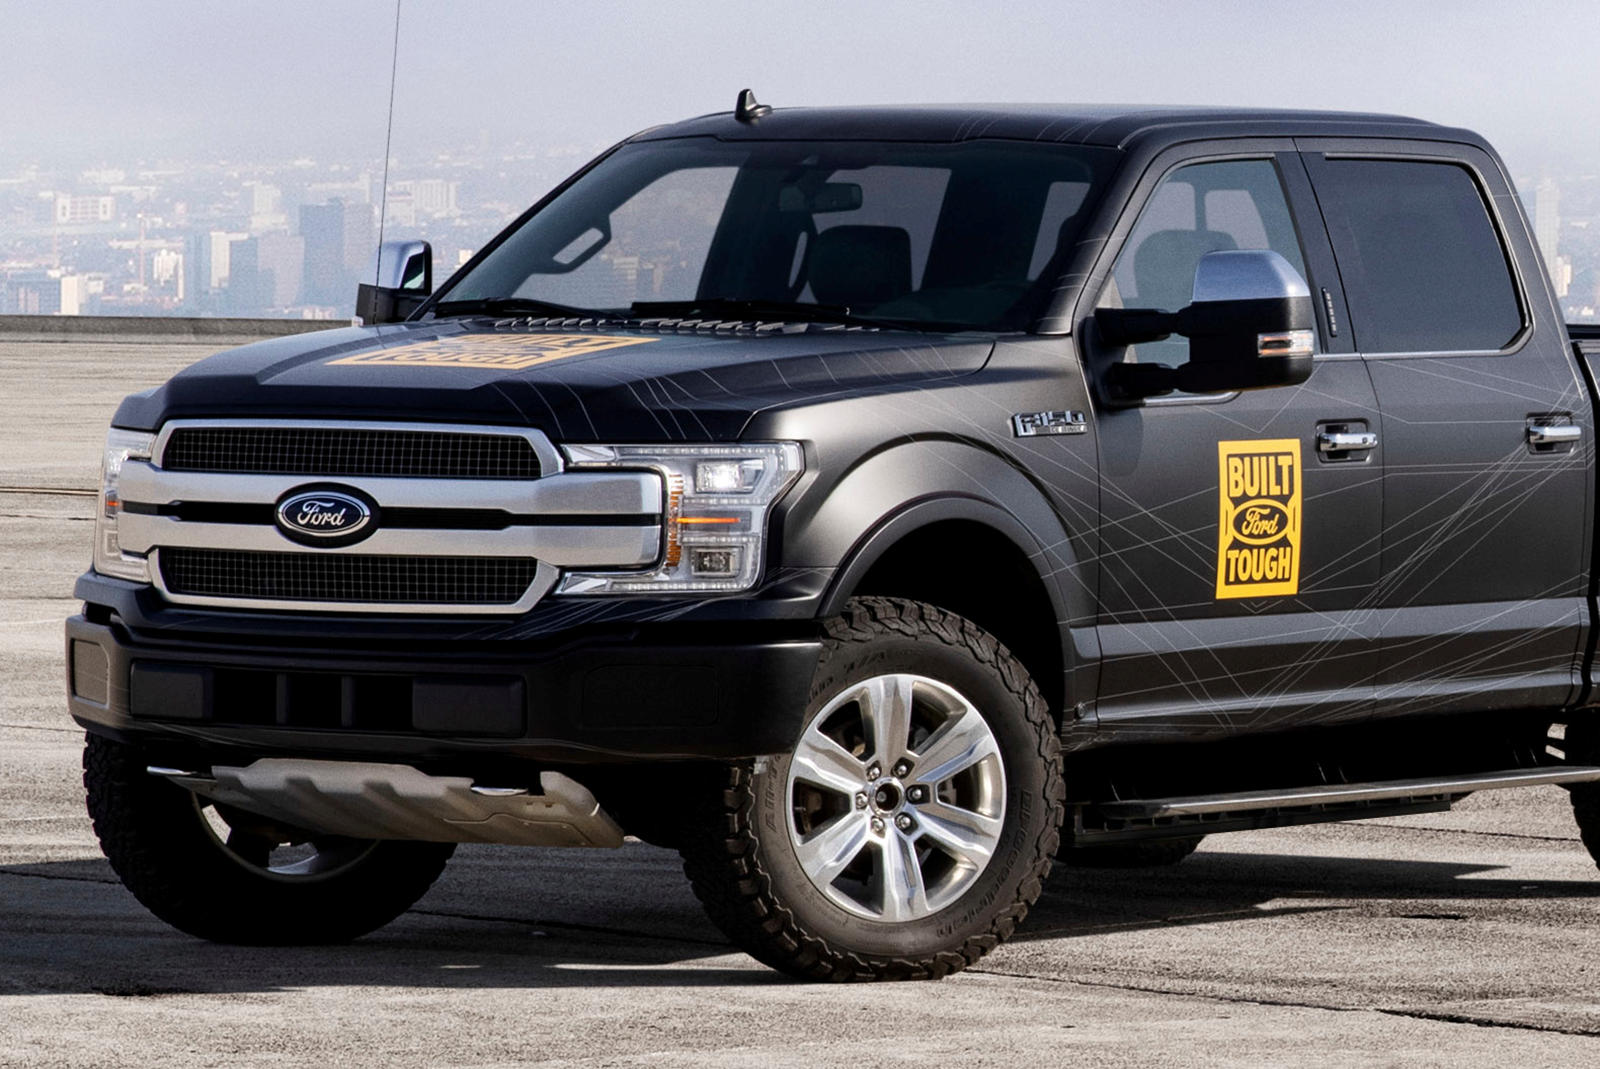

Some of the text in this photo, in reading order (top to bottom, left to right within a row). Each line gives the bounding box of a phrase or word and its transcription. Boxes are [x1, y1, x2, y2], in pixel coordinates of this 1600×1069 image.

[1228, 455, 1293, 498] BUILT
[297, 500, 347, 526] Ford
[1241, 507, 1280, 536] Ford
[1227, 546, 1292, 583] TOUGH
